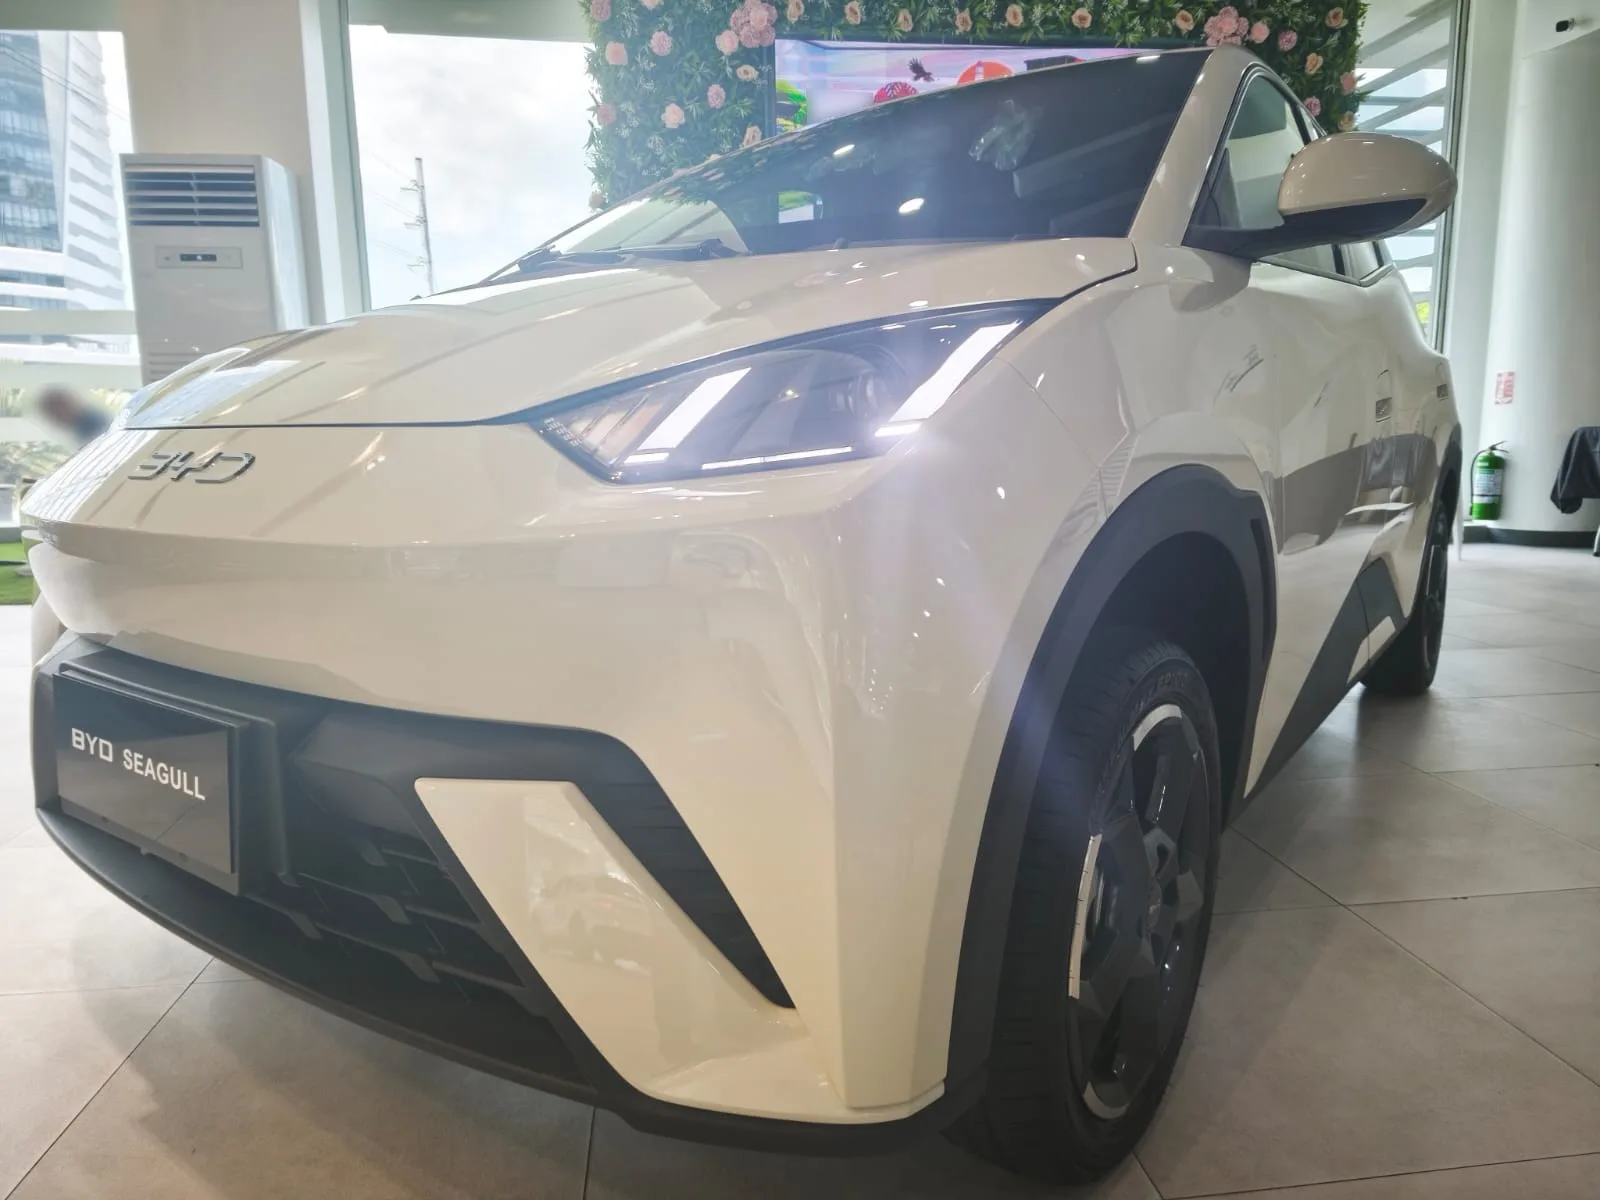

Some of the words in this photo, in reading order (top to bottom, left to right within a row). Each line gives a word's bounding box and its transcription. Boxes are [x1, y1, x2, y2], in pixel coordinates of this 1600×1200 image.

[127, 451, 256, 484] BYD
[71, 727, 113, 763] BYD
[123, 748, 206, 801] SEAGULL
